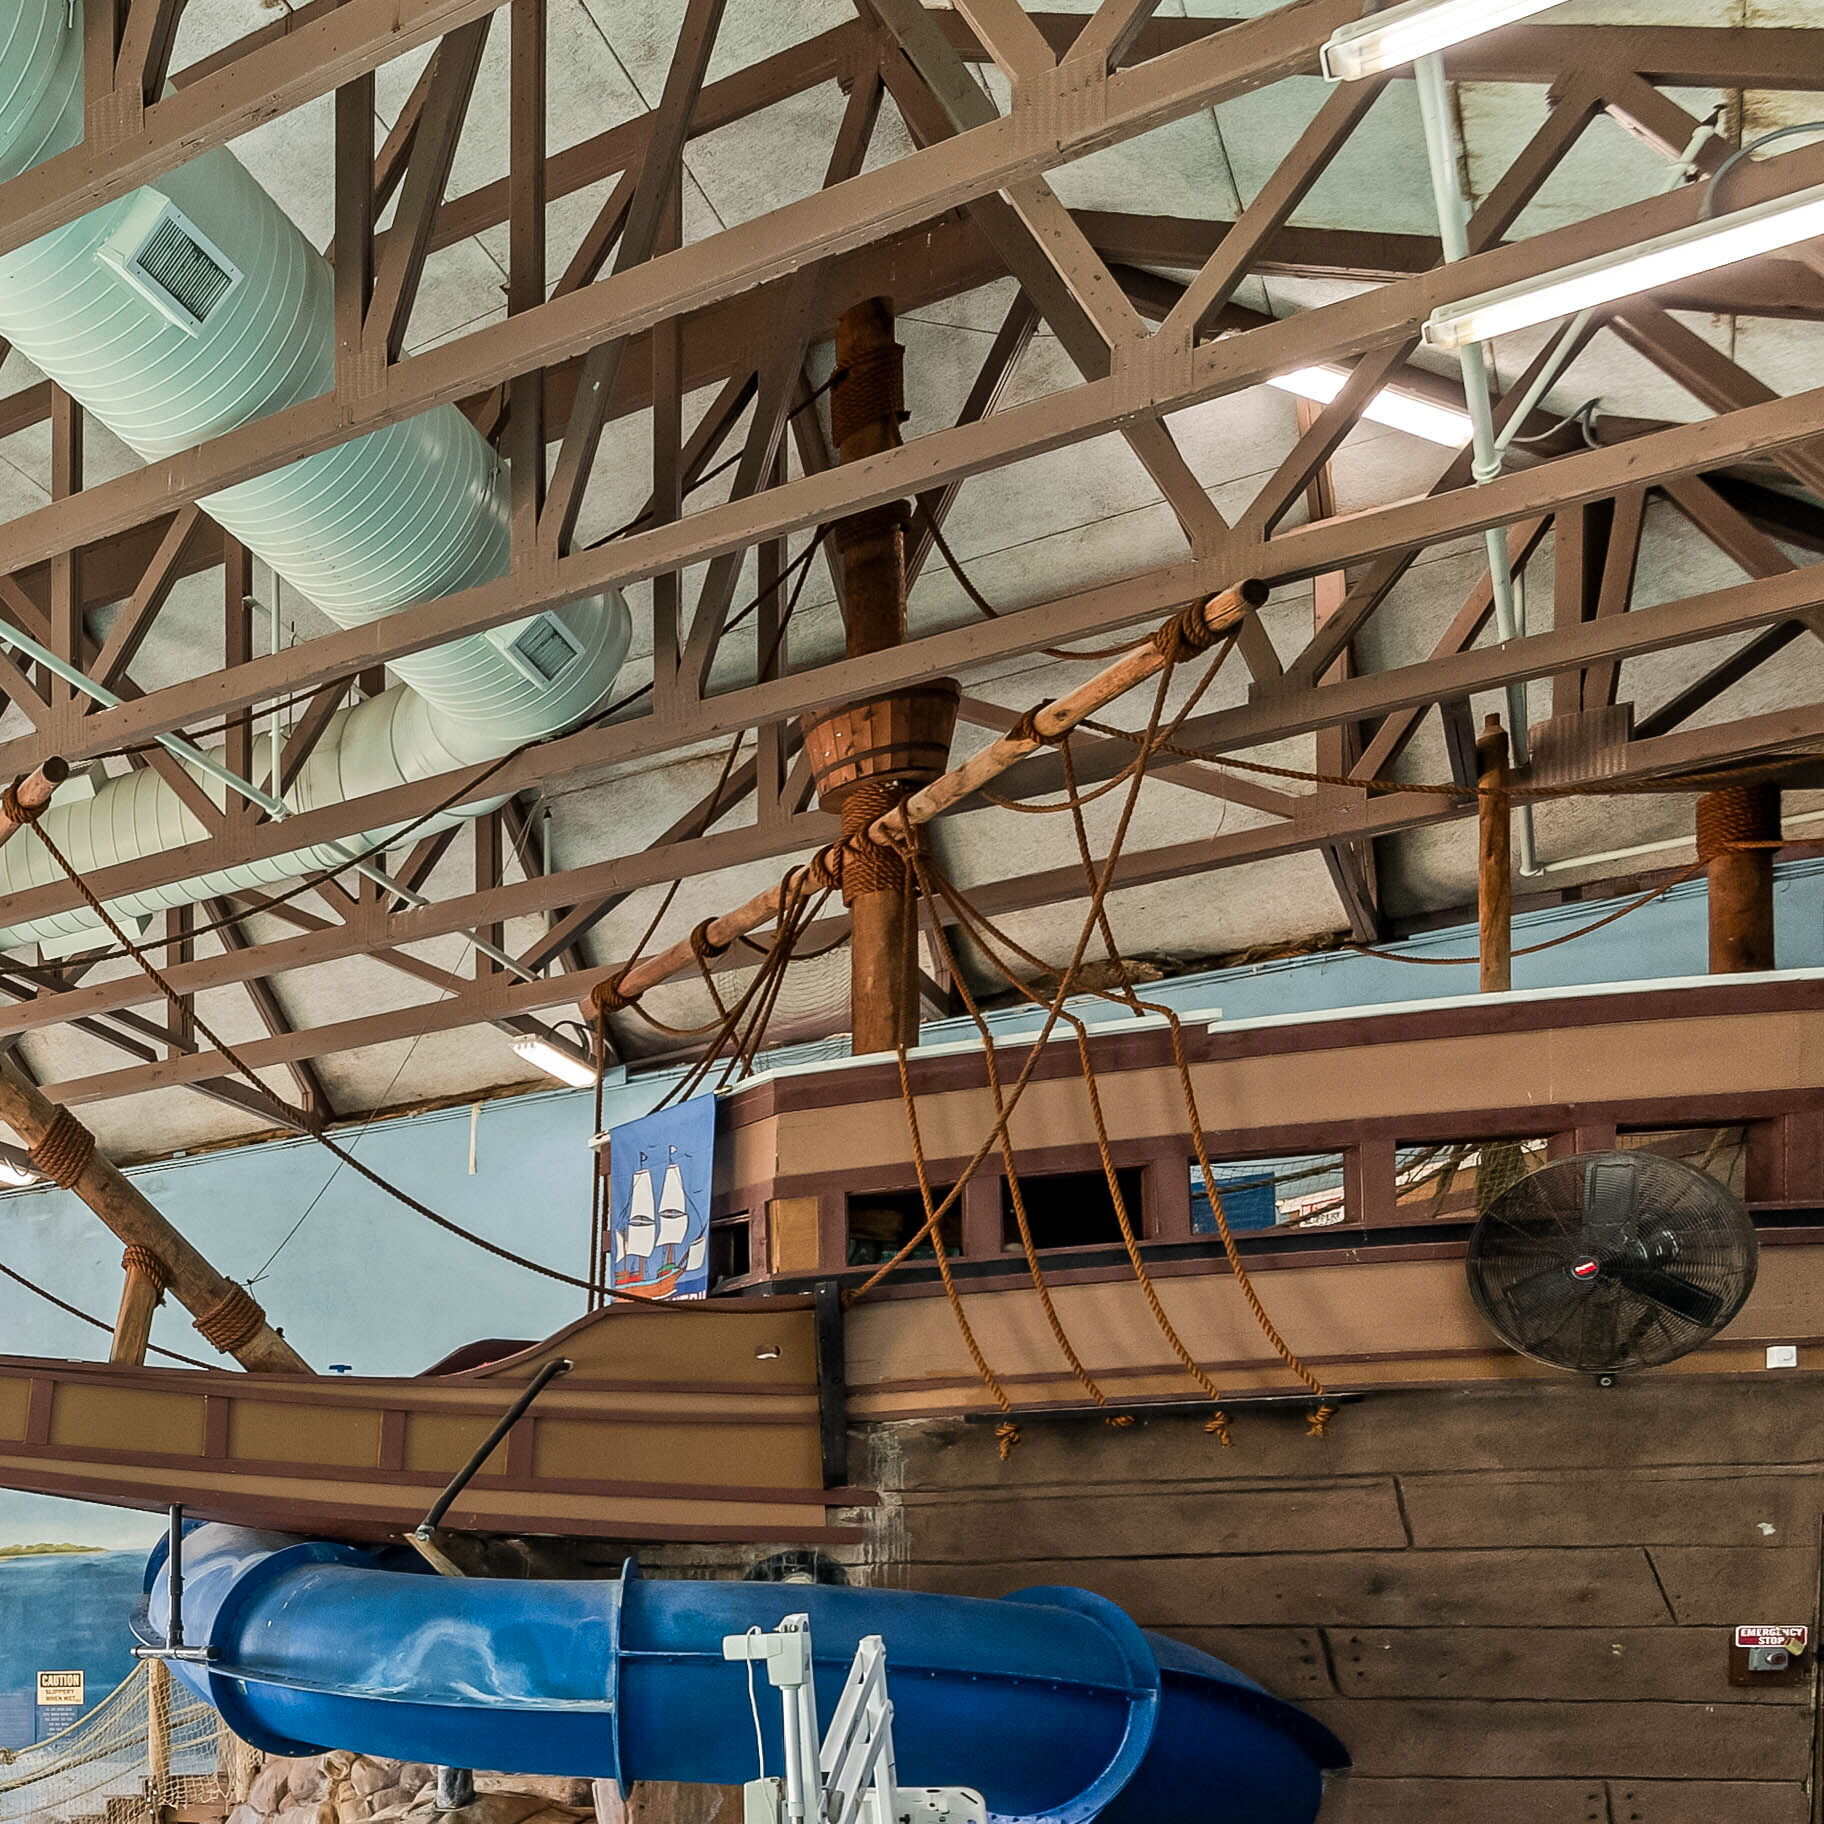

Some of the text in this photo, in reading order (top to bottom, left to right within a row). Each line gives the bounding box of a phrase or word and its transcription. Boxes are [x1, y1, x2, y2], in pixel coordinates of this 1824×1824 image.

[1740, 1628, 1803, 1637] EMERGENCY
[1758, 1637, 1785, 1645] STOP
[42, 1674, 80, 1687] CAUTION
